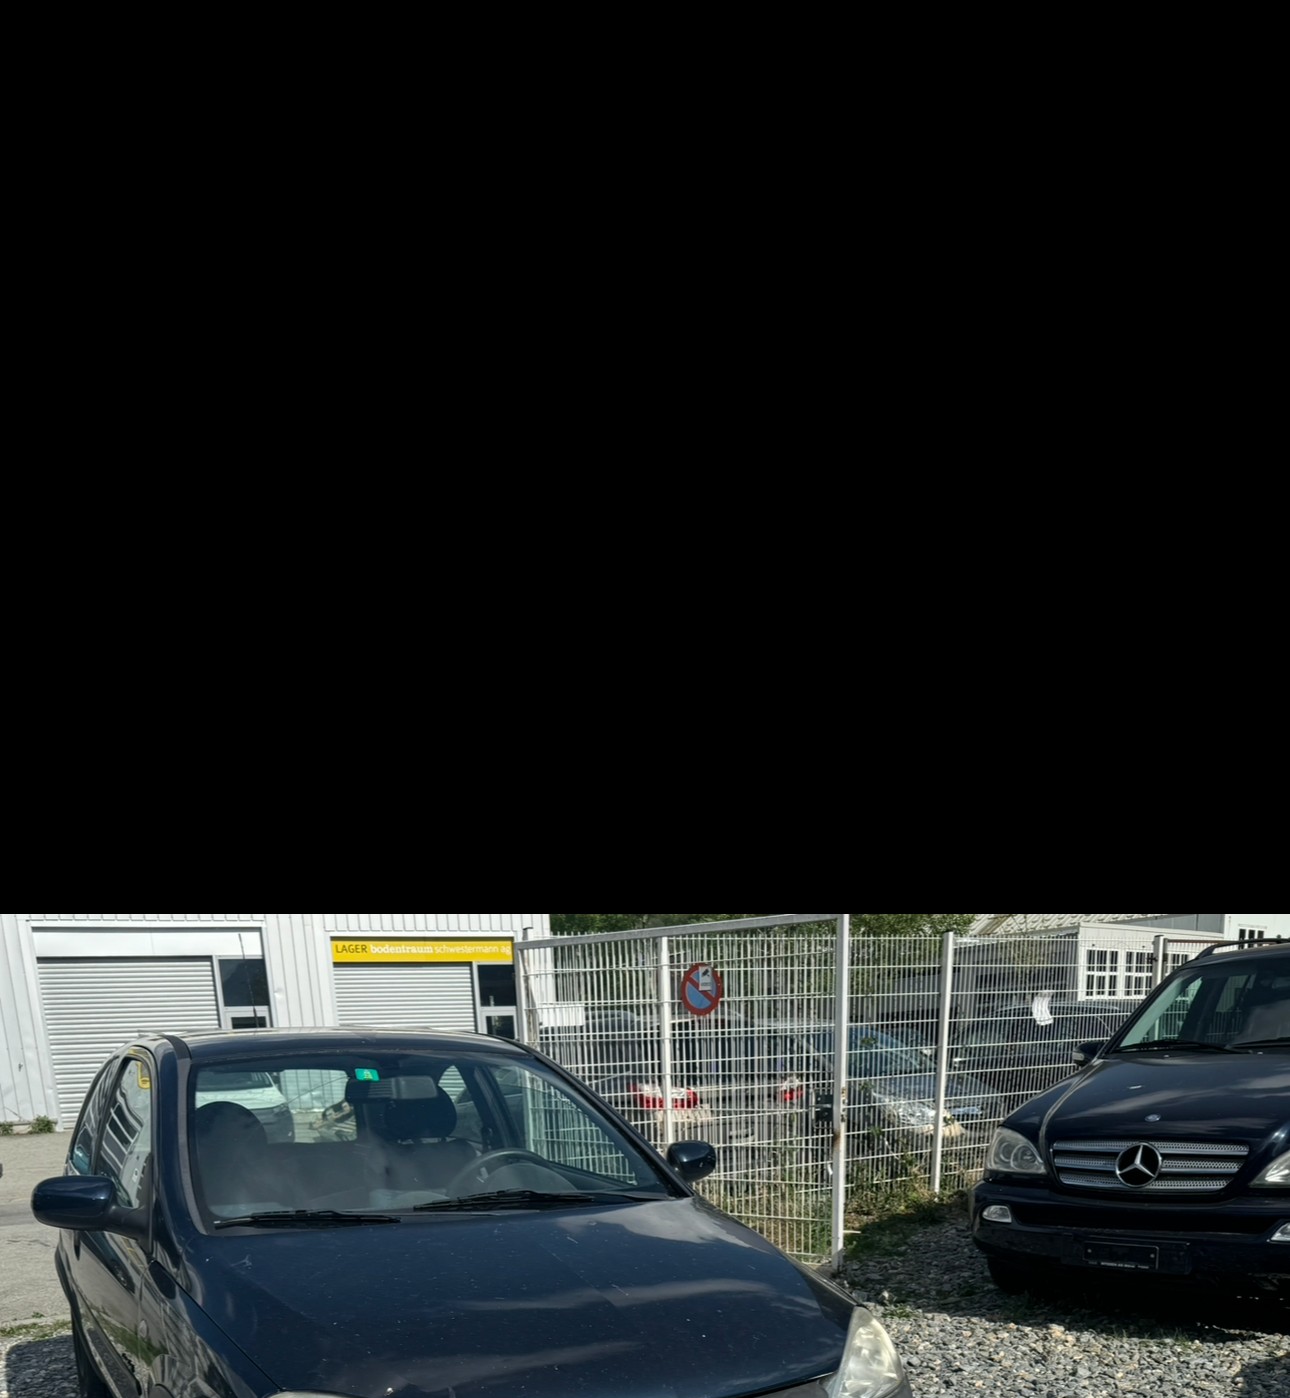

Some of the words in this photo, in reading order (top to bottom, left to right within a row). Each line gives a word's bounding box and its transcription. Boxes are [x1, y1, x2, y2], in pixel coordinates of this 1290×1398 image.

[335, 944, 368, 954] LAGER
[370, 944, 433, 954] bodentraum
[435, 944, 499, 954] schwestermann
[501, 946, 511, 956] ag
